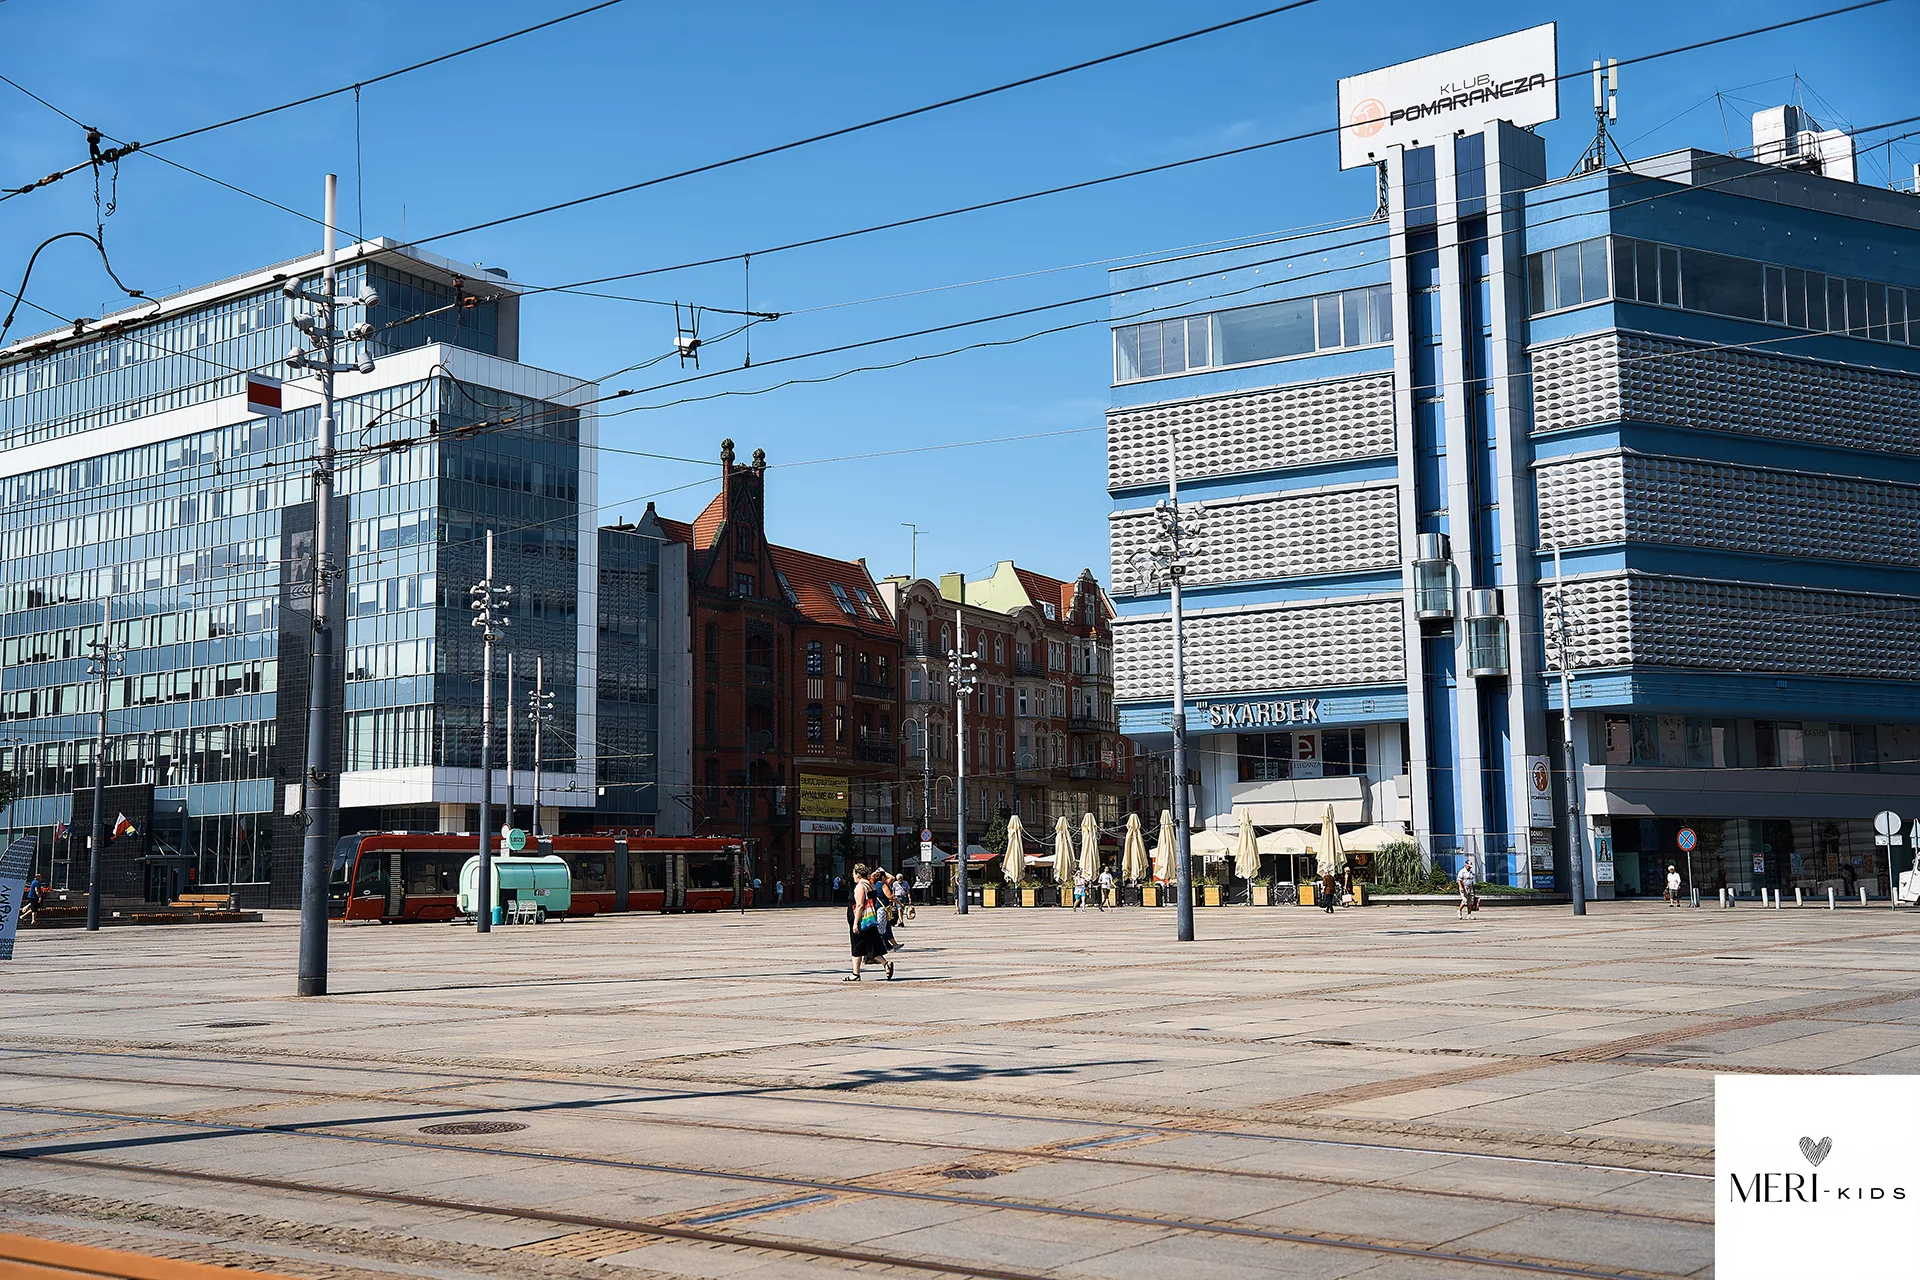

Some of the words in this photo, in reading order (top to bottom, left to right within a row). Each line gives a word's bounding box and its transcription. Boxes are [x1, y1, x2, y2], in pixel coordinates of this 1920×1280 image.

[1440, 73, 1491, 96] KLUB
[1390, 72, 1546, 126] POMARAŃCZA
[1209, 698, 1320, 726] SKARBEK
[1293, 761, 1321, 769] ELEGANZA
